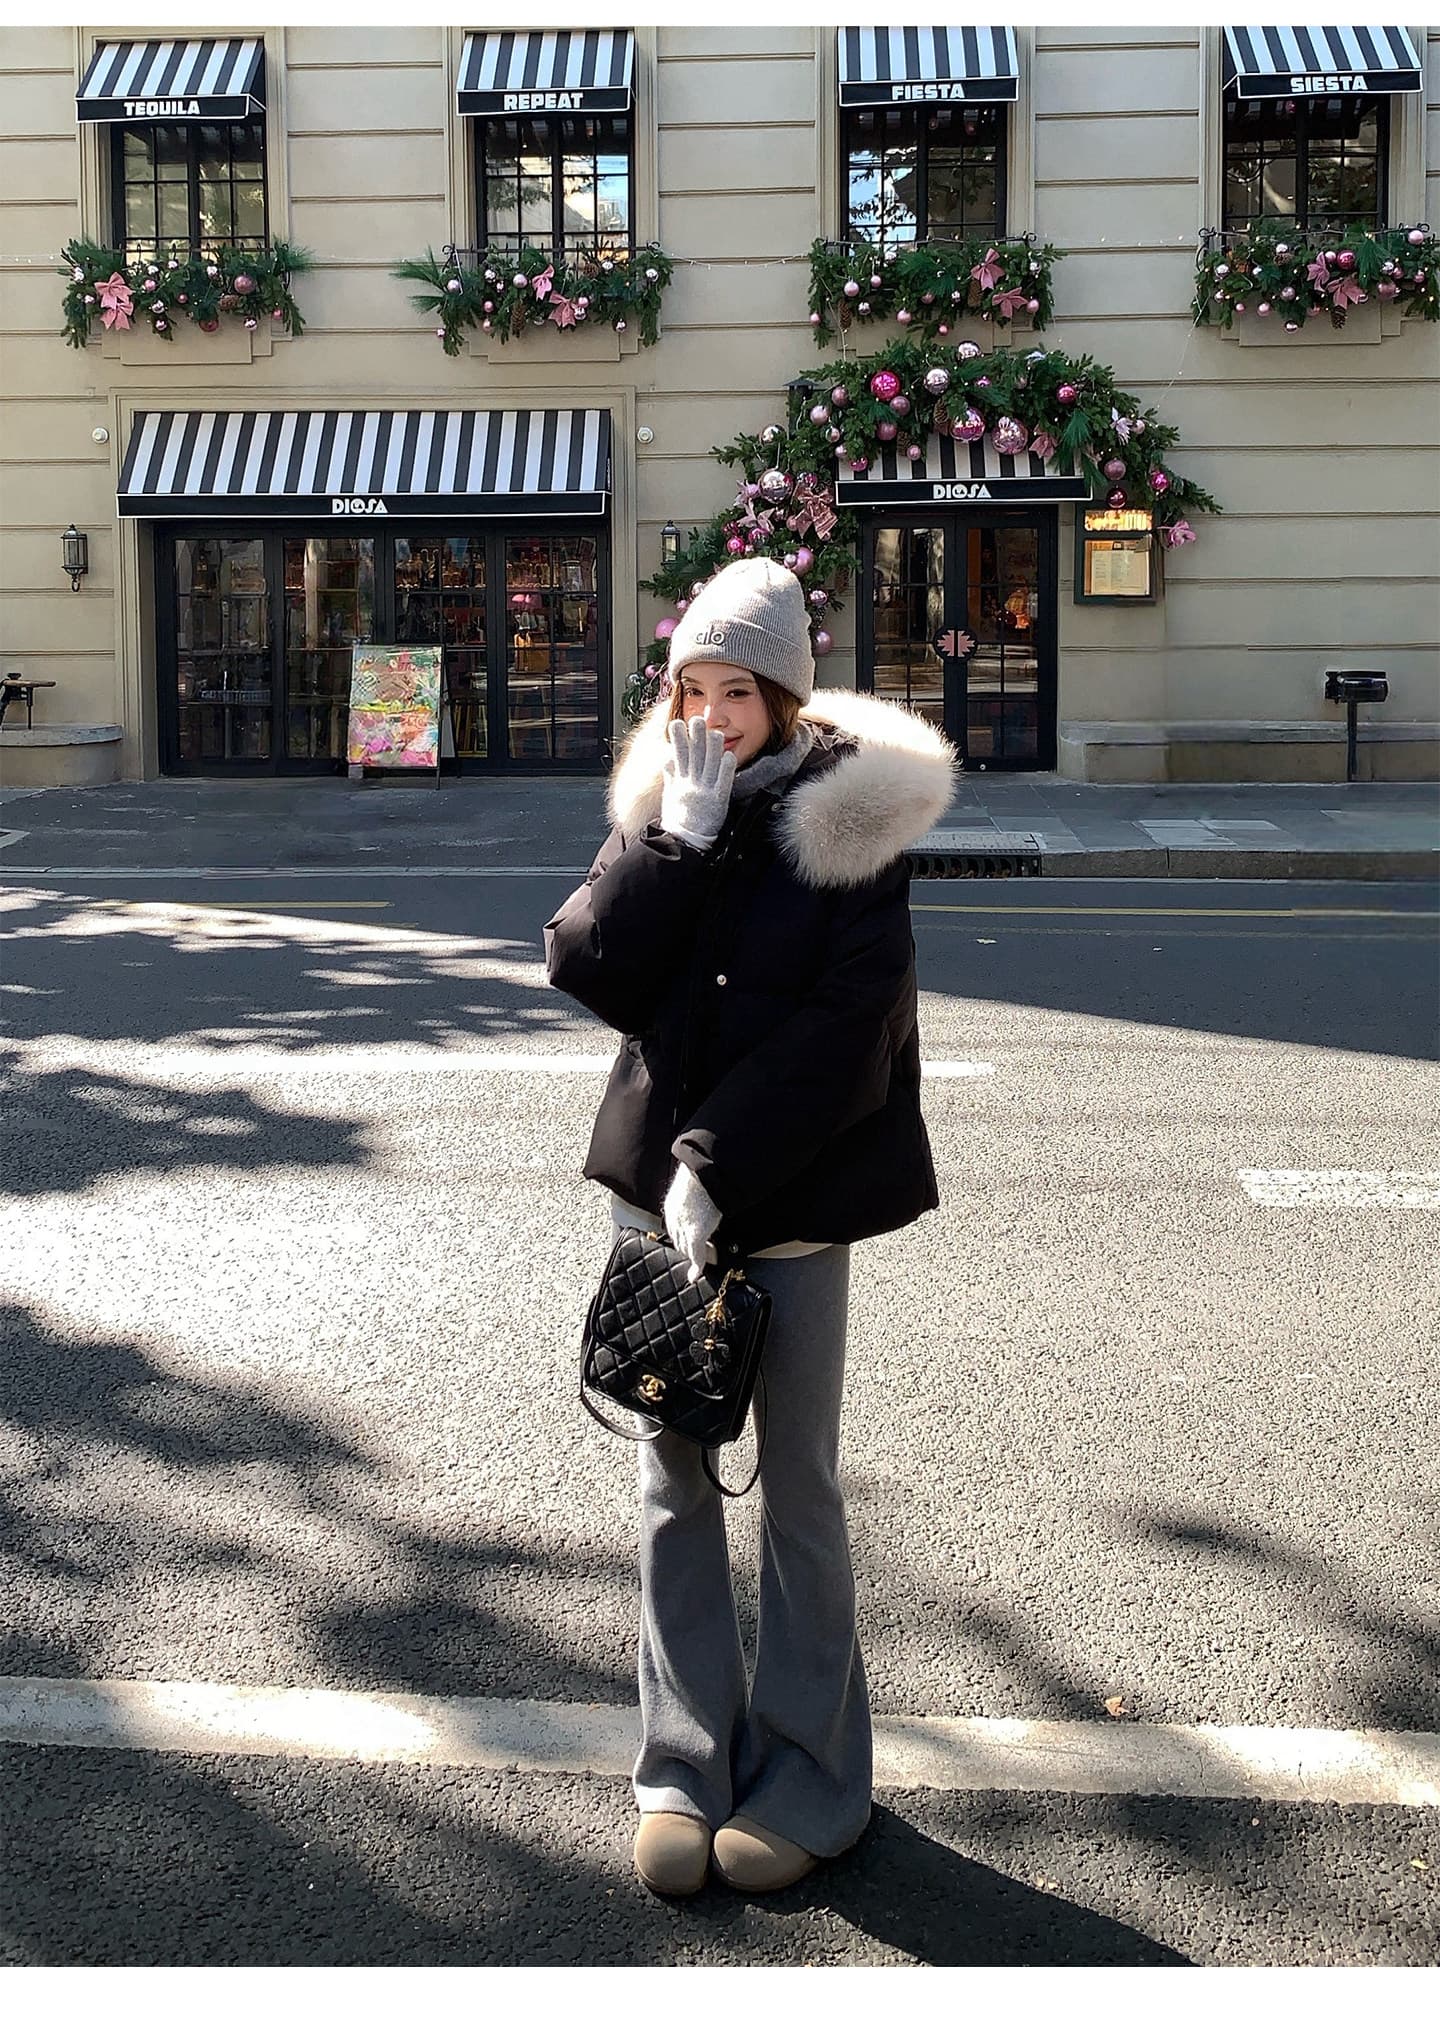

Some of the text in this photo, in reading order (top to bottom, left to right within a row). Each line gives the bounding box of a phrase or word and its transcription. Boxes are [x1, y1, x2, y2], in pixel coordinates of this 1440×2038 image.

[1290, 75, 1368, 92] SIESTA
[891, 84, 965, 100] FIESTA
[124, 101, 200, 116] TEQUILA
[503, 92, 584, 110] REPEAT
[932, 483, 992, 499] DIOSA
[332, 498, 389, 514] DIOSA
[695, 625, 726, 646] alo
